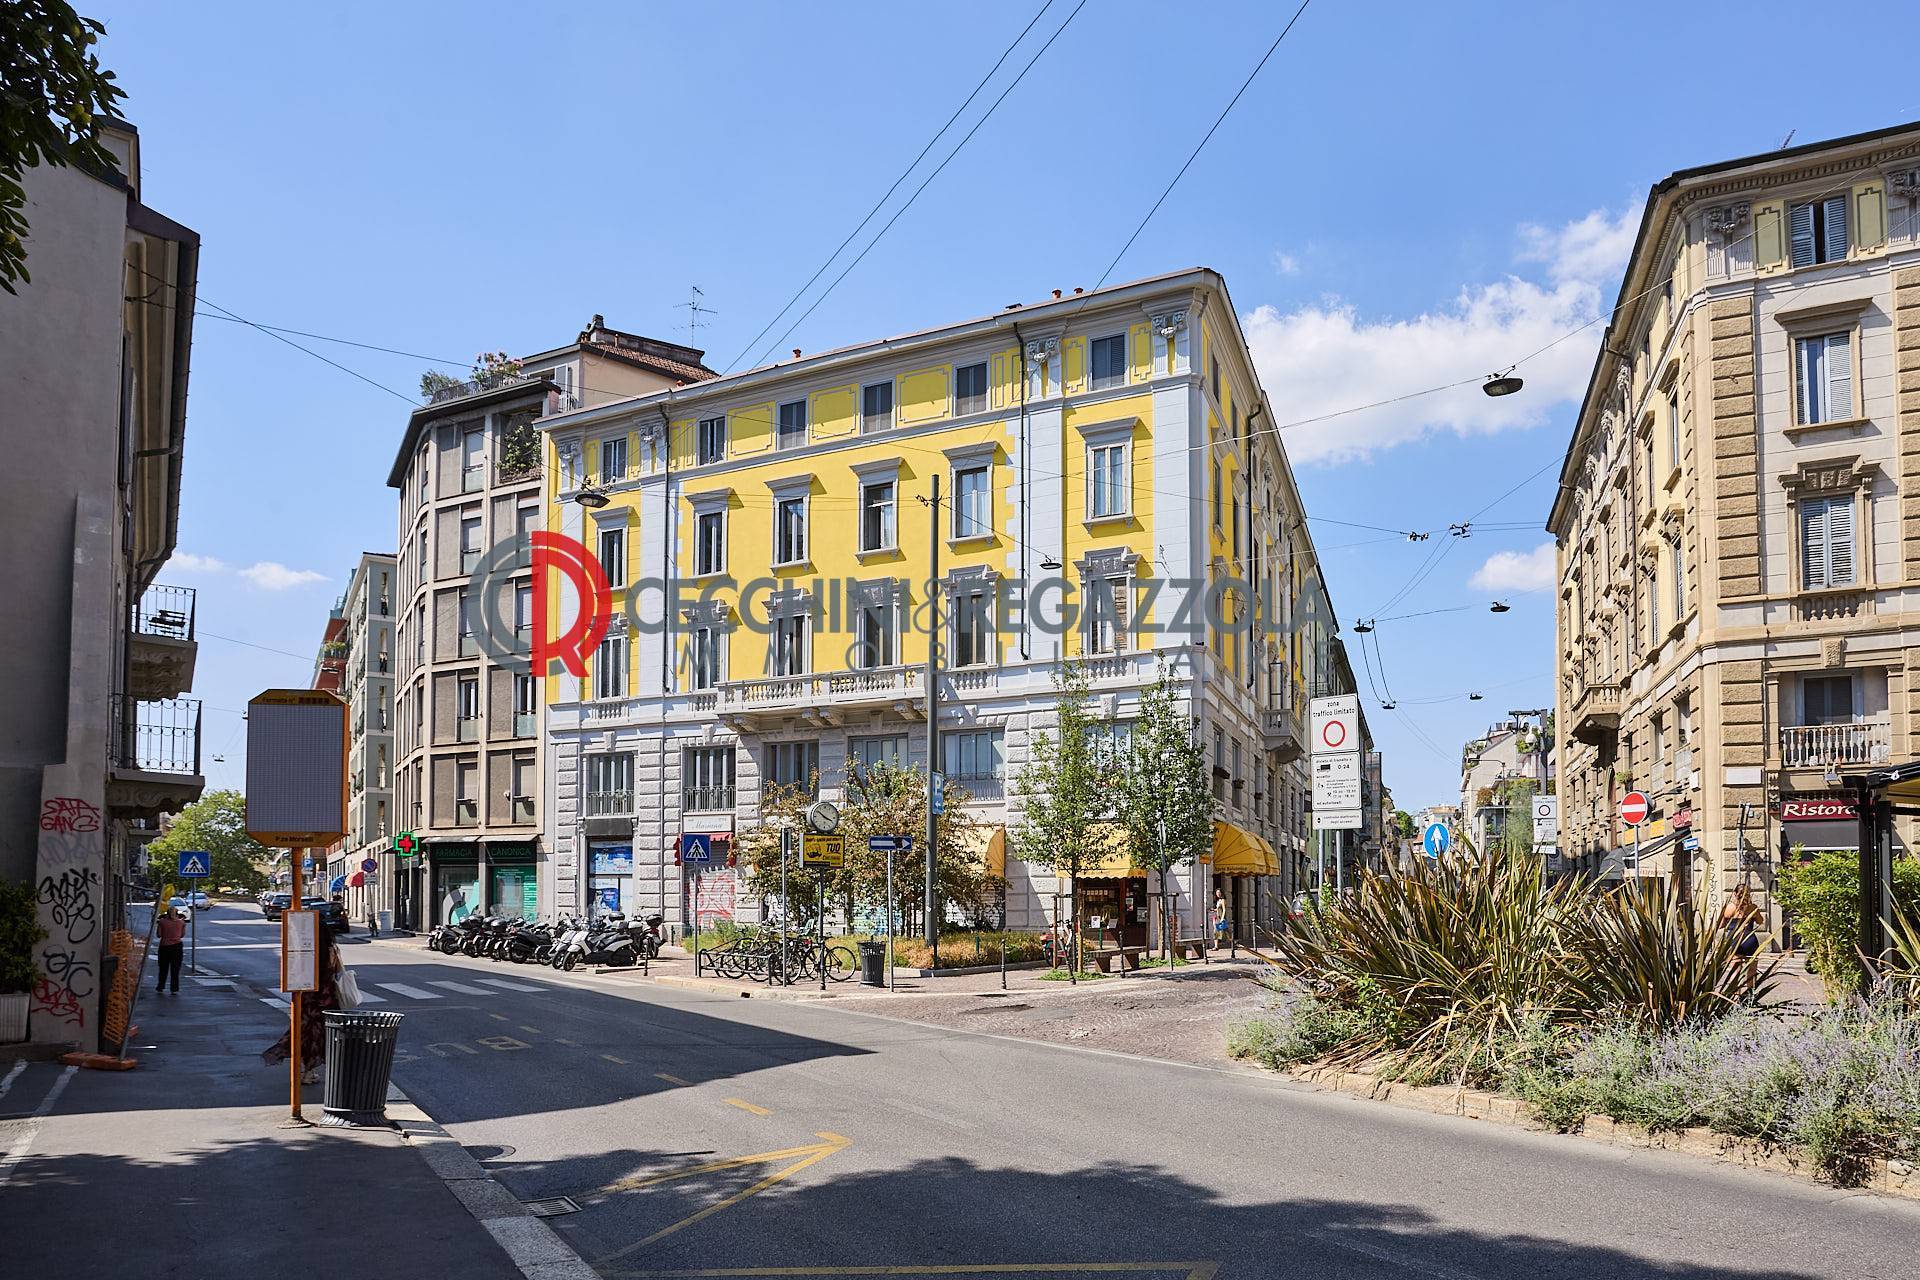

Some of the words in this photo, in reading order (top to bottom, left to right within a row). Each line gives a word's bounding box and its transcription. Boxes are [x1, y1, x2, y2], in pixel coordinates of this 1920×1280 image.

[1334, 708, 1355, 716] limitato
[436, 848, 472, 856] FARMACIA
[490, 848, 532, 856] CANONICA
